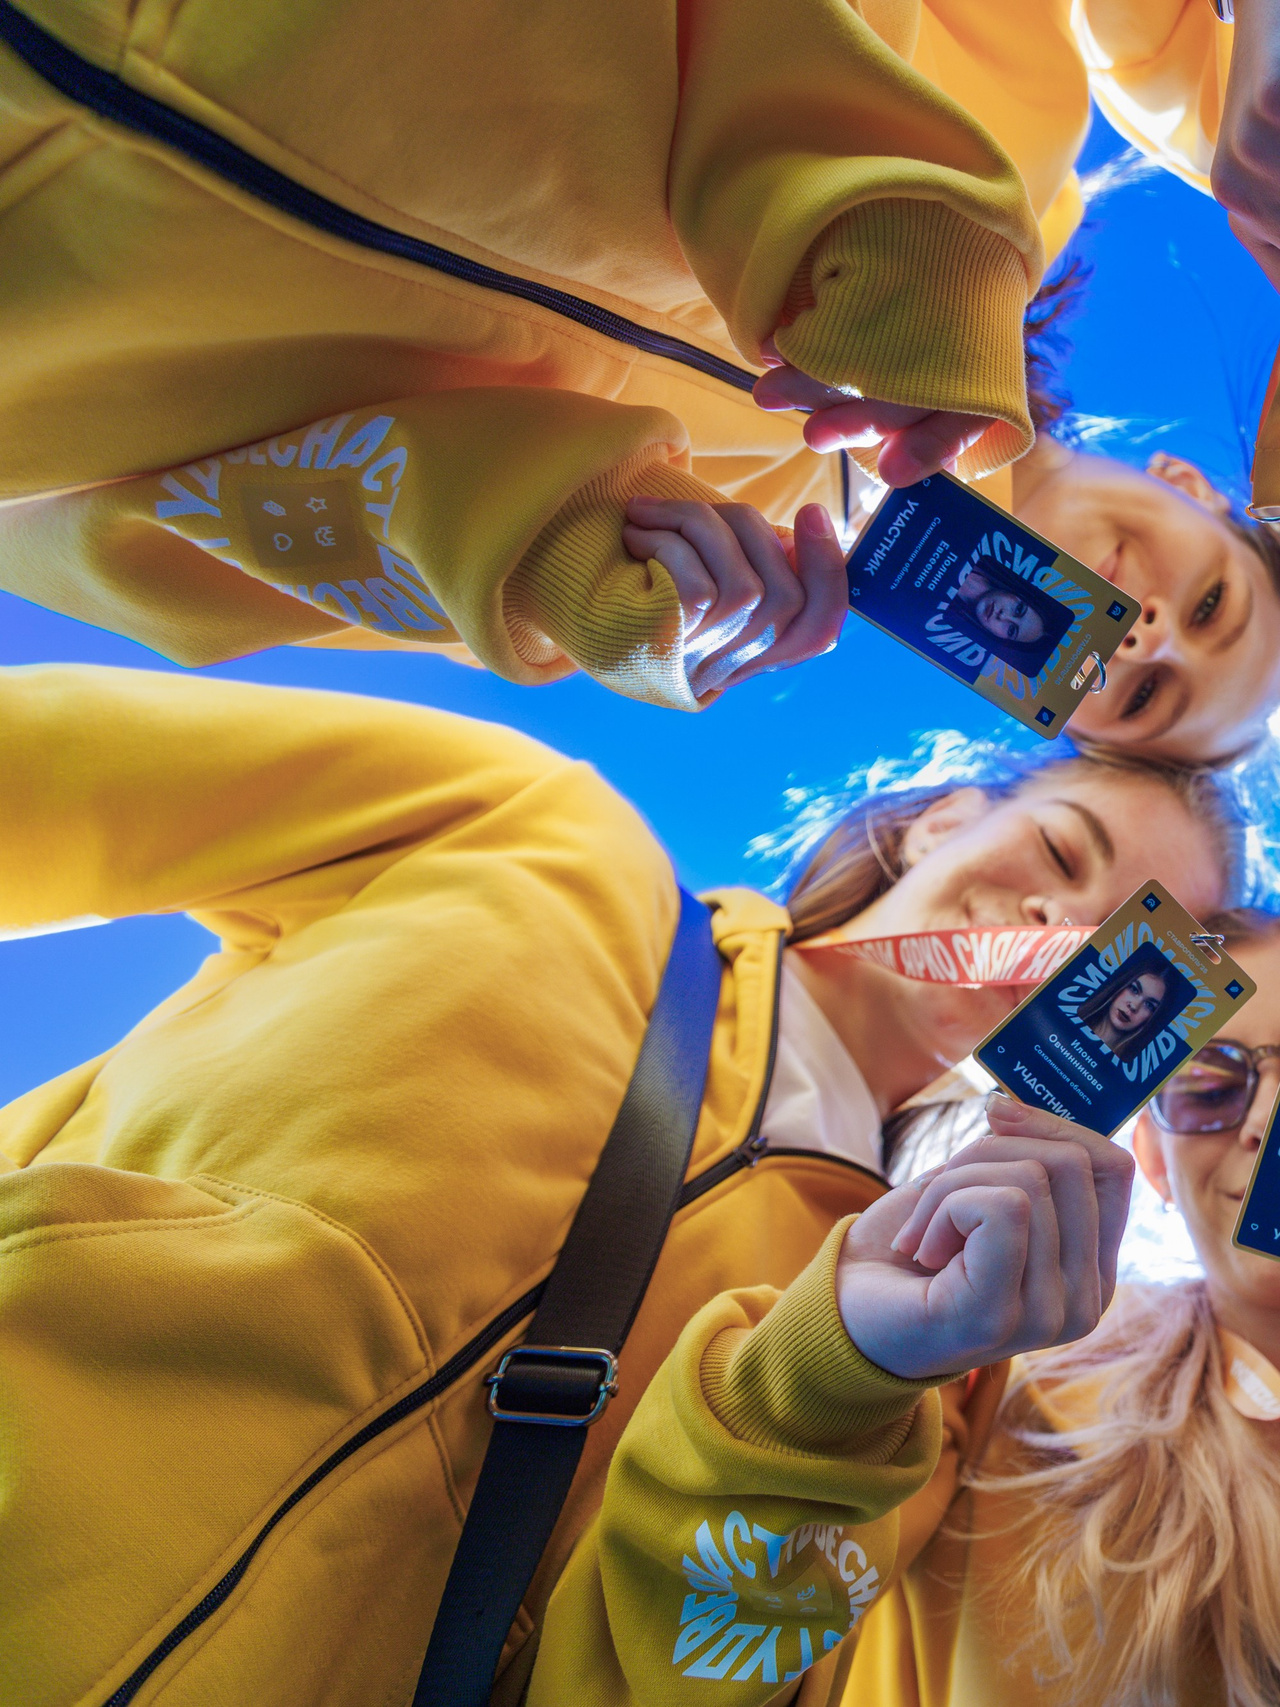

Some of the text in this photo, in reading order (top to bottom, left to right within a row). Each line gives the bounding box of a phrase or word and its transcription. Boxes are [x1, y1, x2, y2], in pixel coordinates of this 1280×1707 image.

[863, 499, 920, 577] УЧАСТНИК
[889, 516, 942, 591] Сахалинская область
[913, 540, 950, 588] Евсеенко
[927, 551, 959, 592] Полина
[1033, 1044, 1093, 1106] Сахалинская область
[1048, 1033, 1104, 1092] Овчинникова
[1070, 1039, 1098, 1069] Илона
